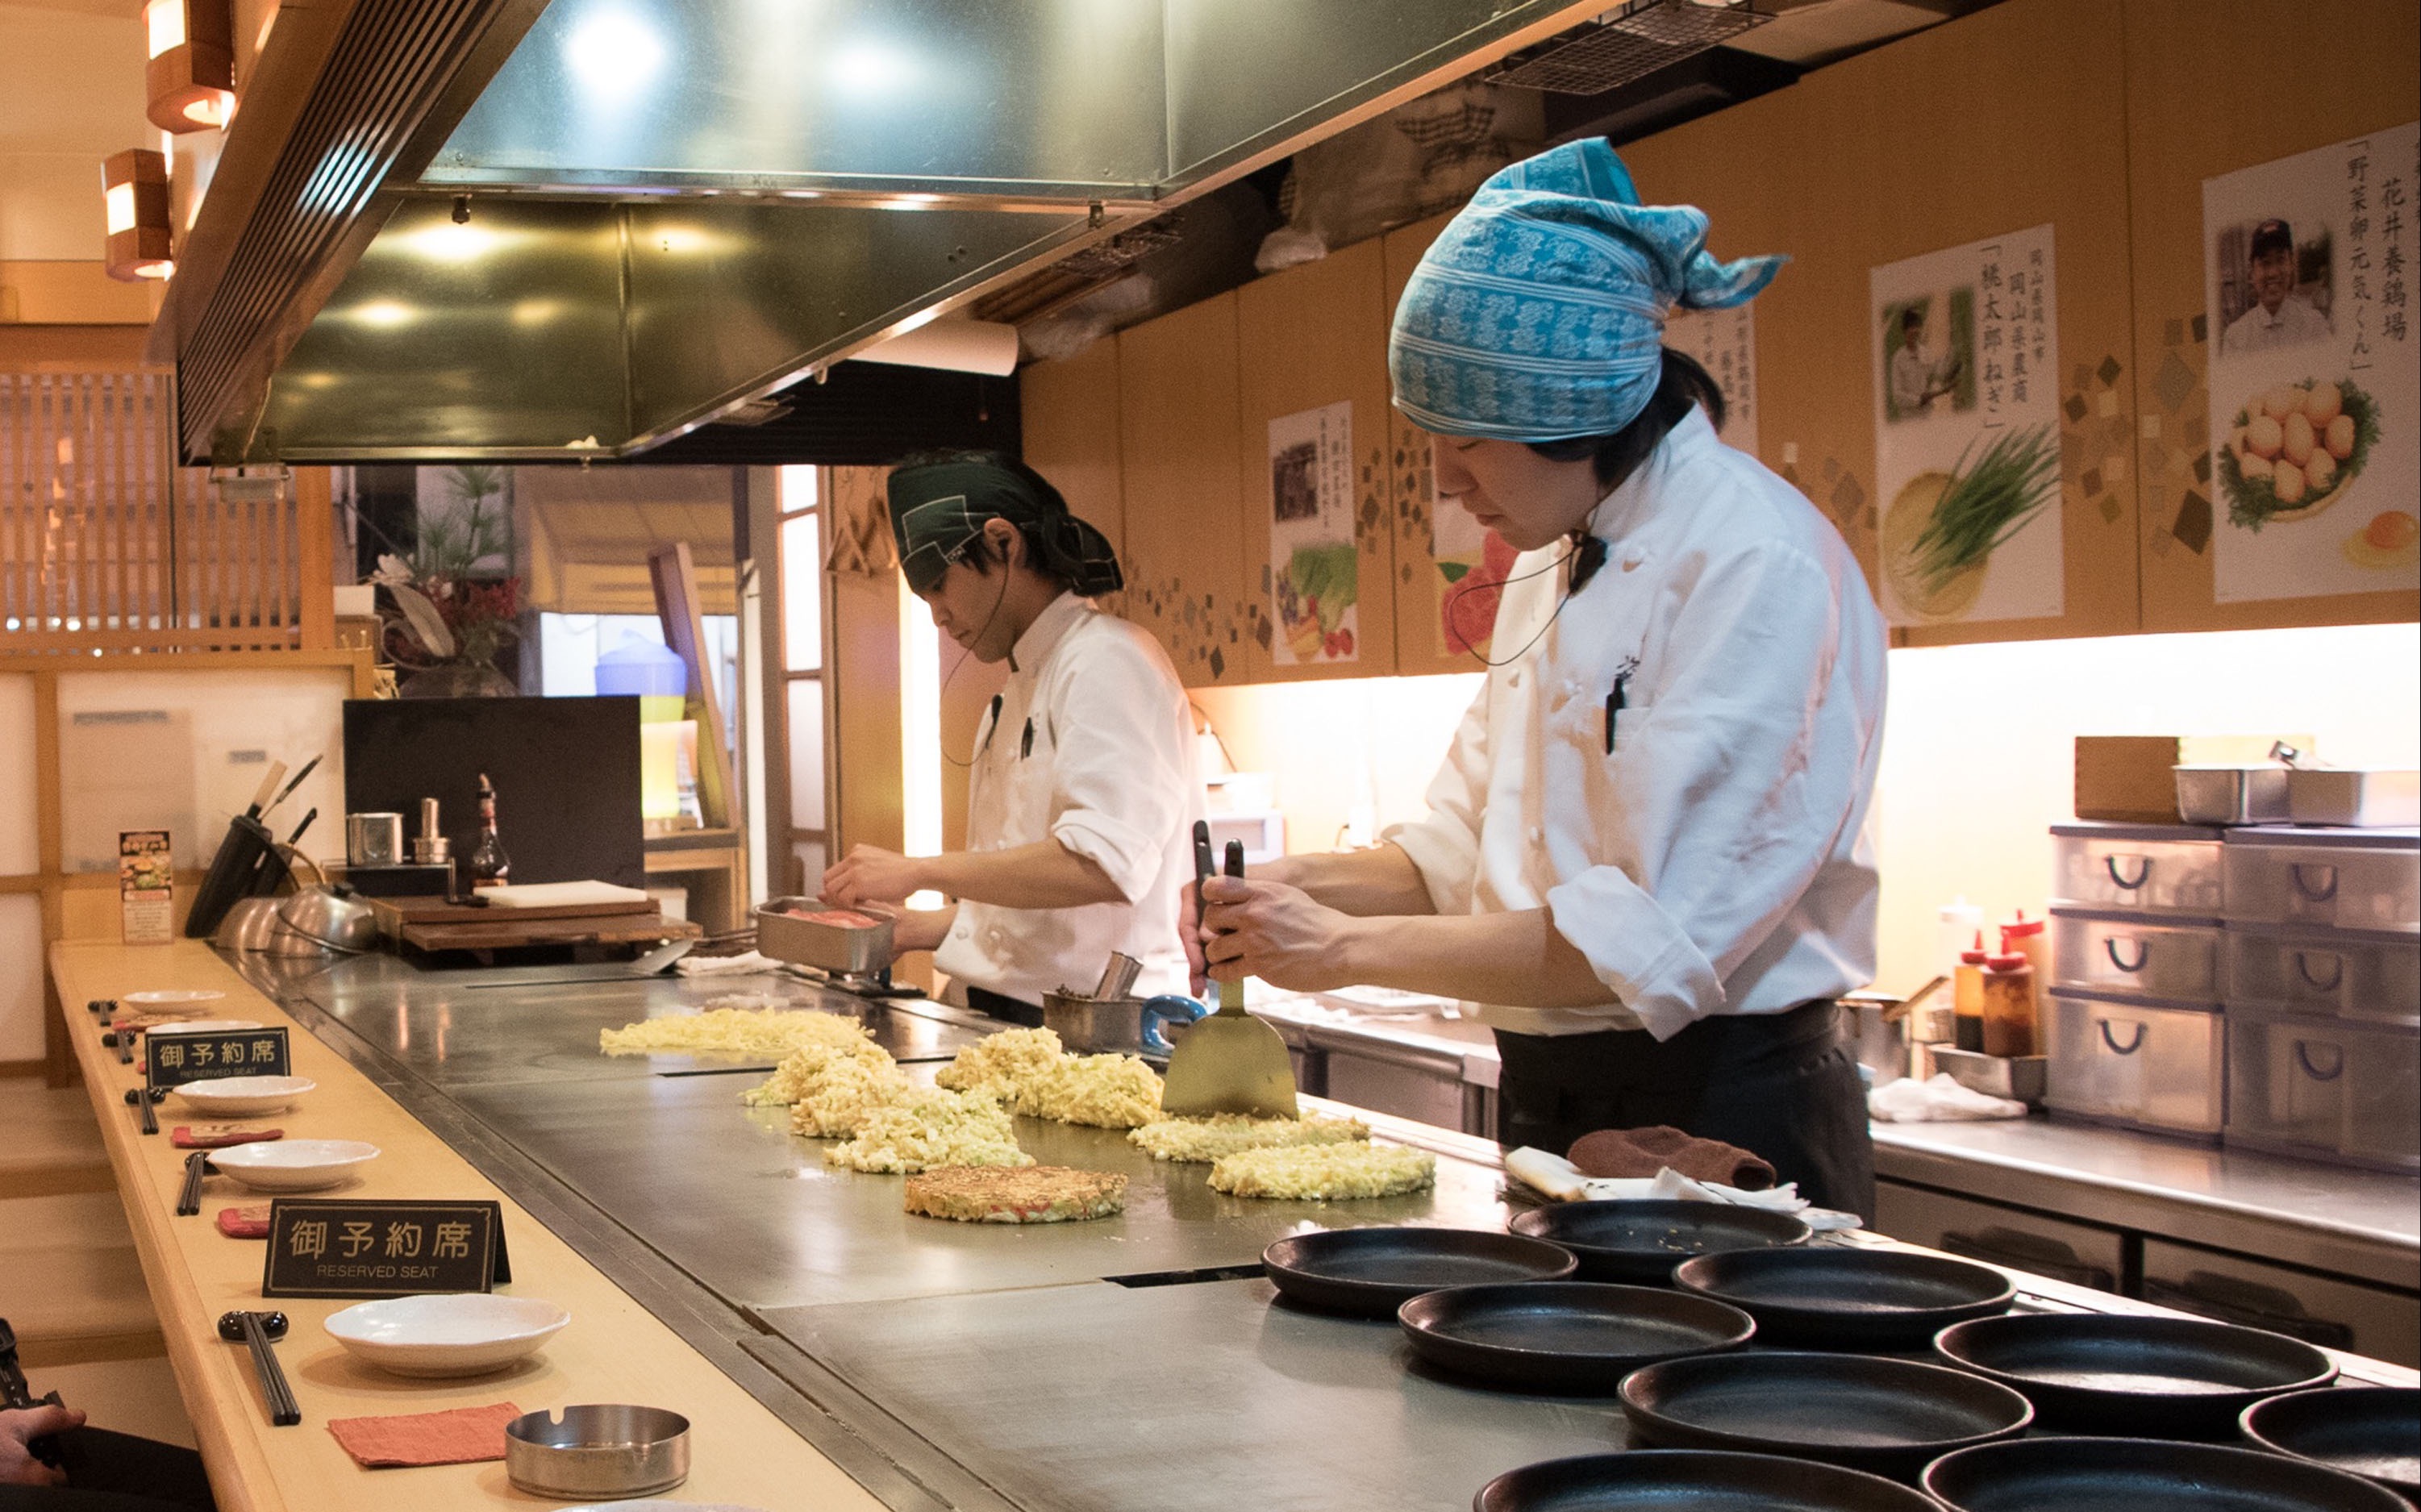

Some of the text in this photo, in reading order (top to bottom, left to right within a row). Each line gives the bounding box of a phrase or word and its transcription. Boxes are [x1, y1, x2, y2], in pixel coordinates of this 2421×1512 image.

[2381, 177, 2407, 342] 花井養鶏場
[160, 1039, 275, 1068] 御予約席
[179, 1069, 232, 1079] RESERVED
[290, 1220, 472, 1260] 御予約席
[317, 1264, 439, 1278] RESERVED SEAT
